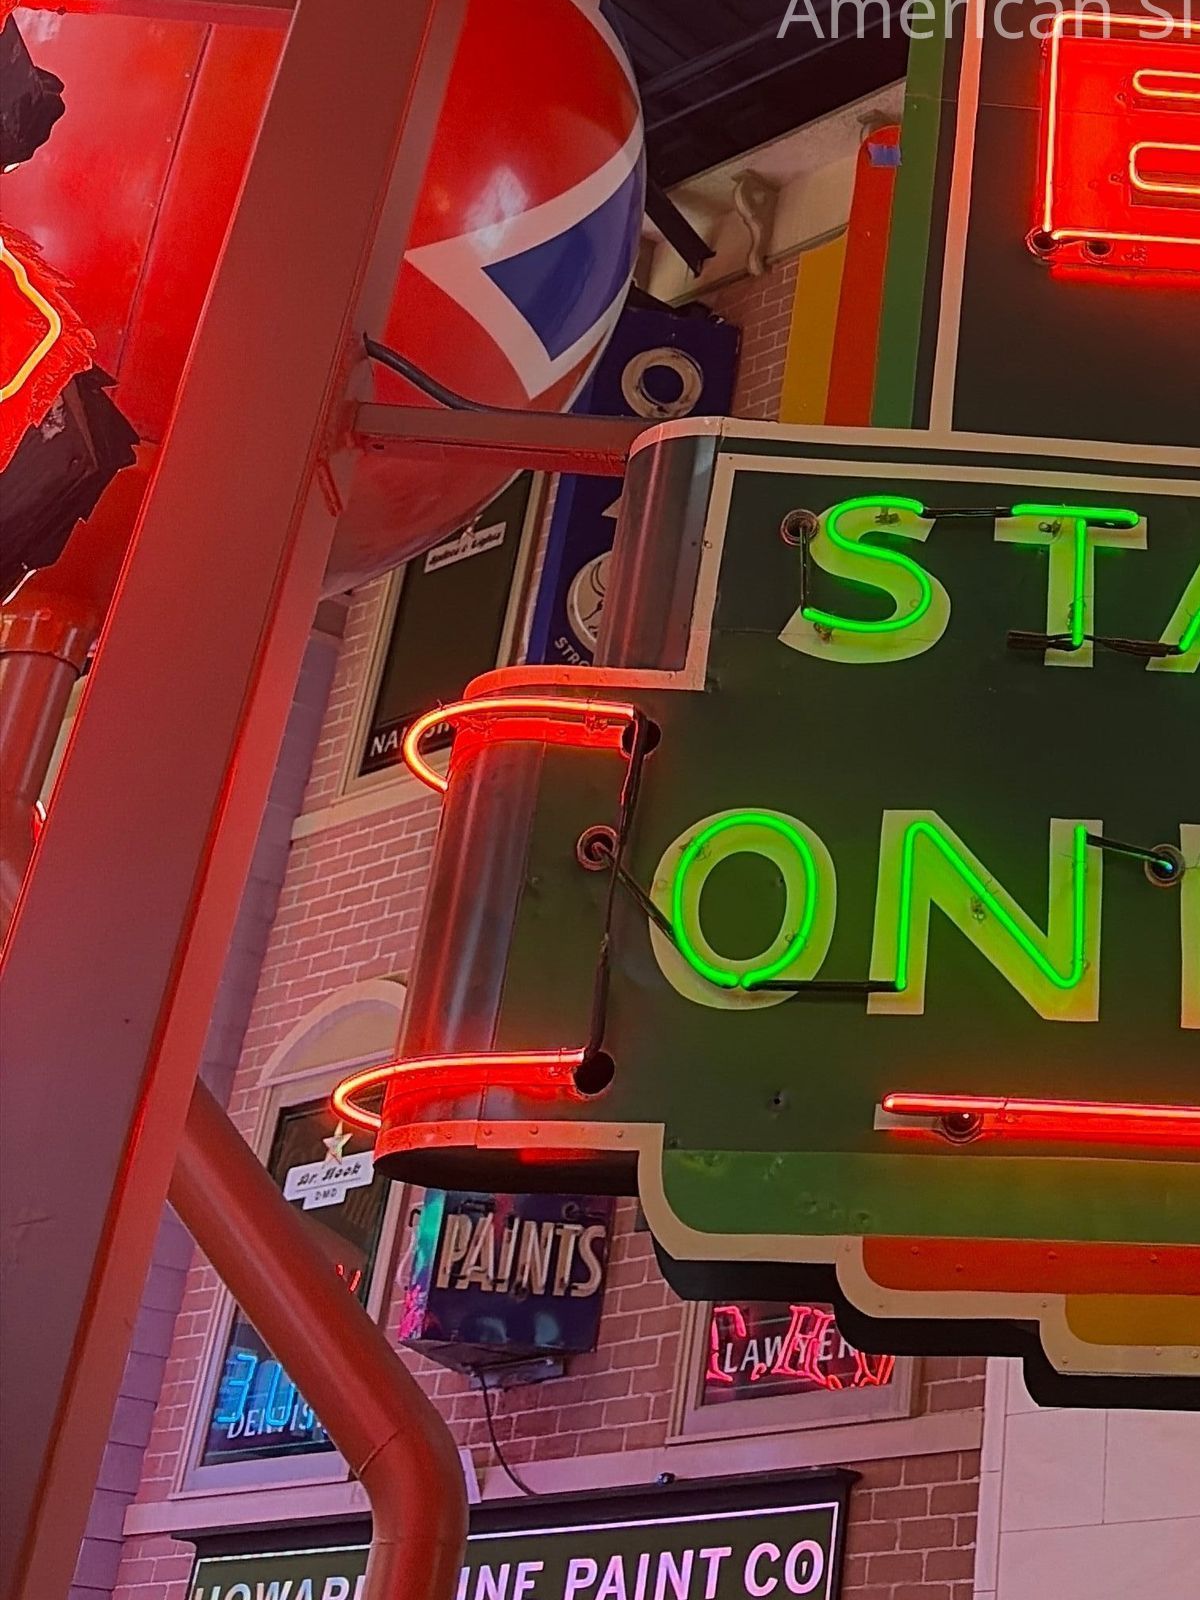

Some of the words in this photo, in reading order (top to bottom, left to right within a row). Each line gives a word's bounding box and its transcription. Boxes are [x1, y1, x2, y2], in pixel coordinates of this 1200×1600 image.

[435, 1211, 608, 1298] PAINTS
[226, 1402, 328, 1440] DENTIS
[563, 1546, 732, 1600] PAINT
[743, 1539, 825, 1597] CO
